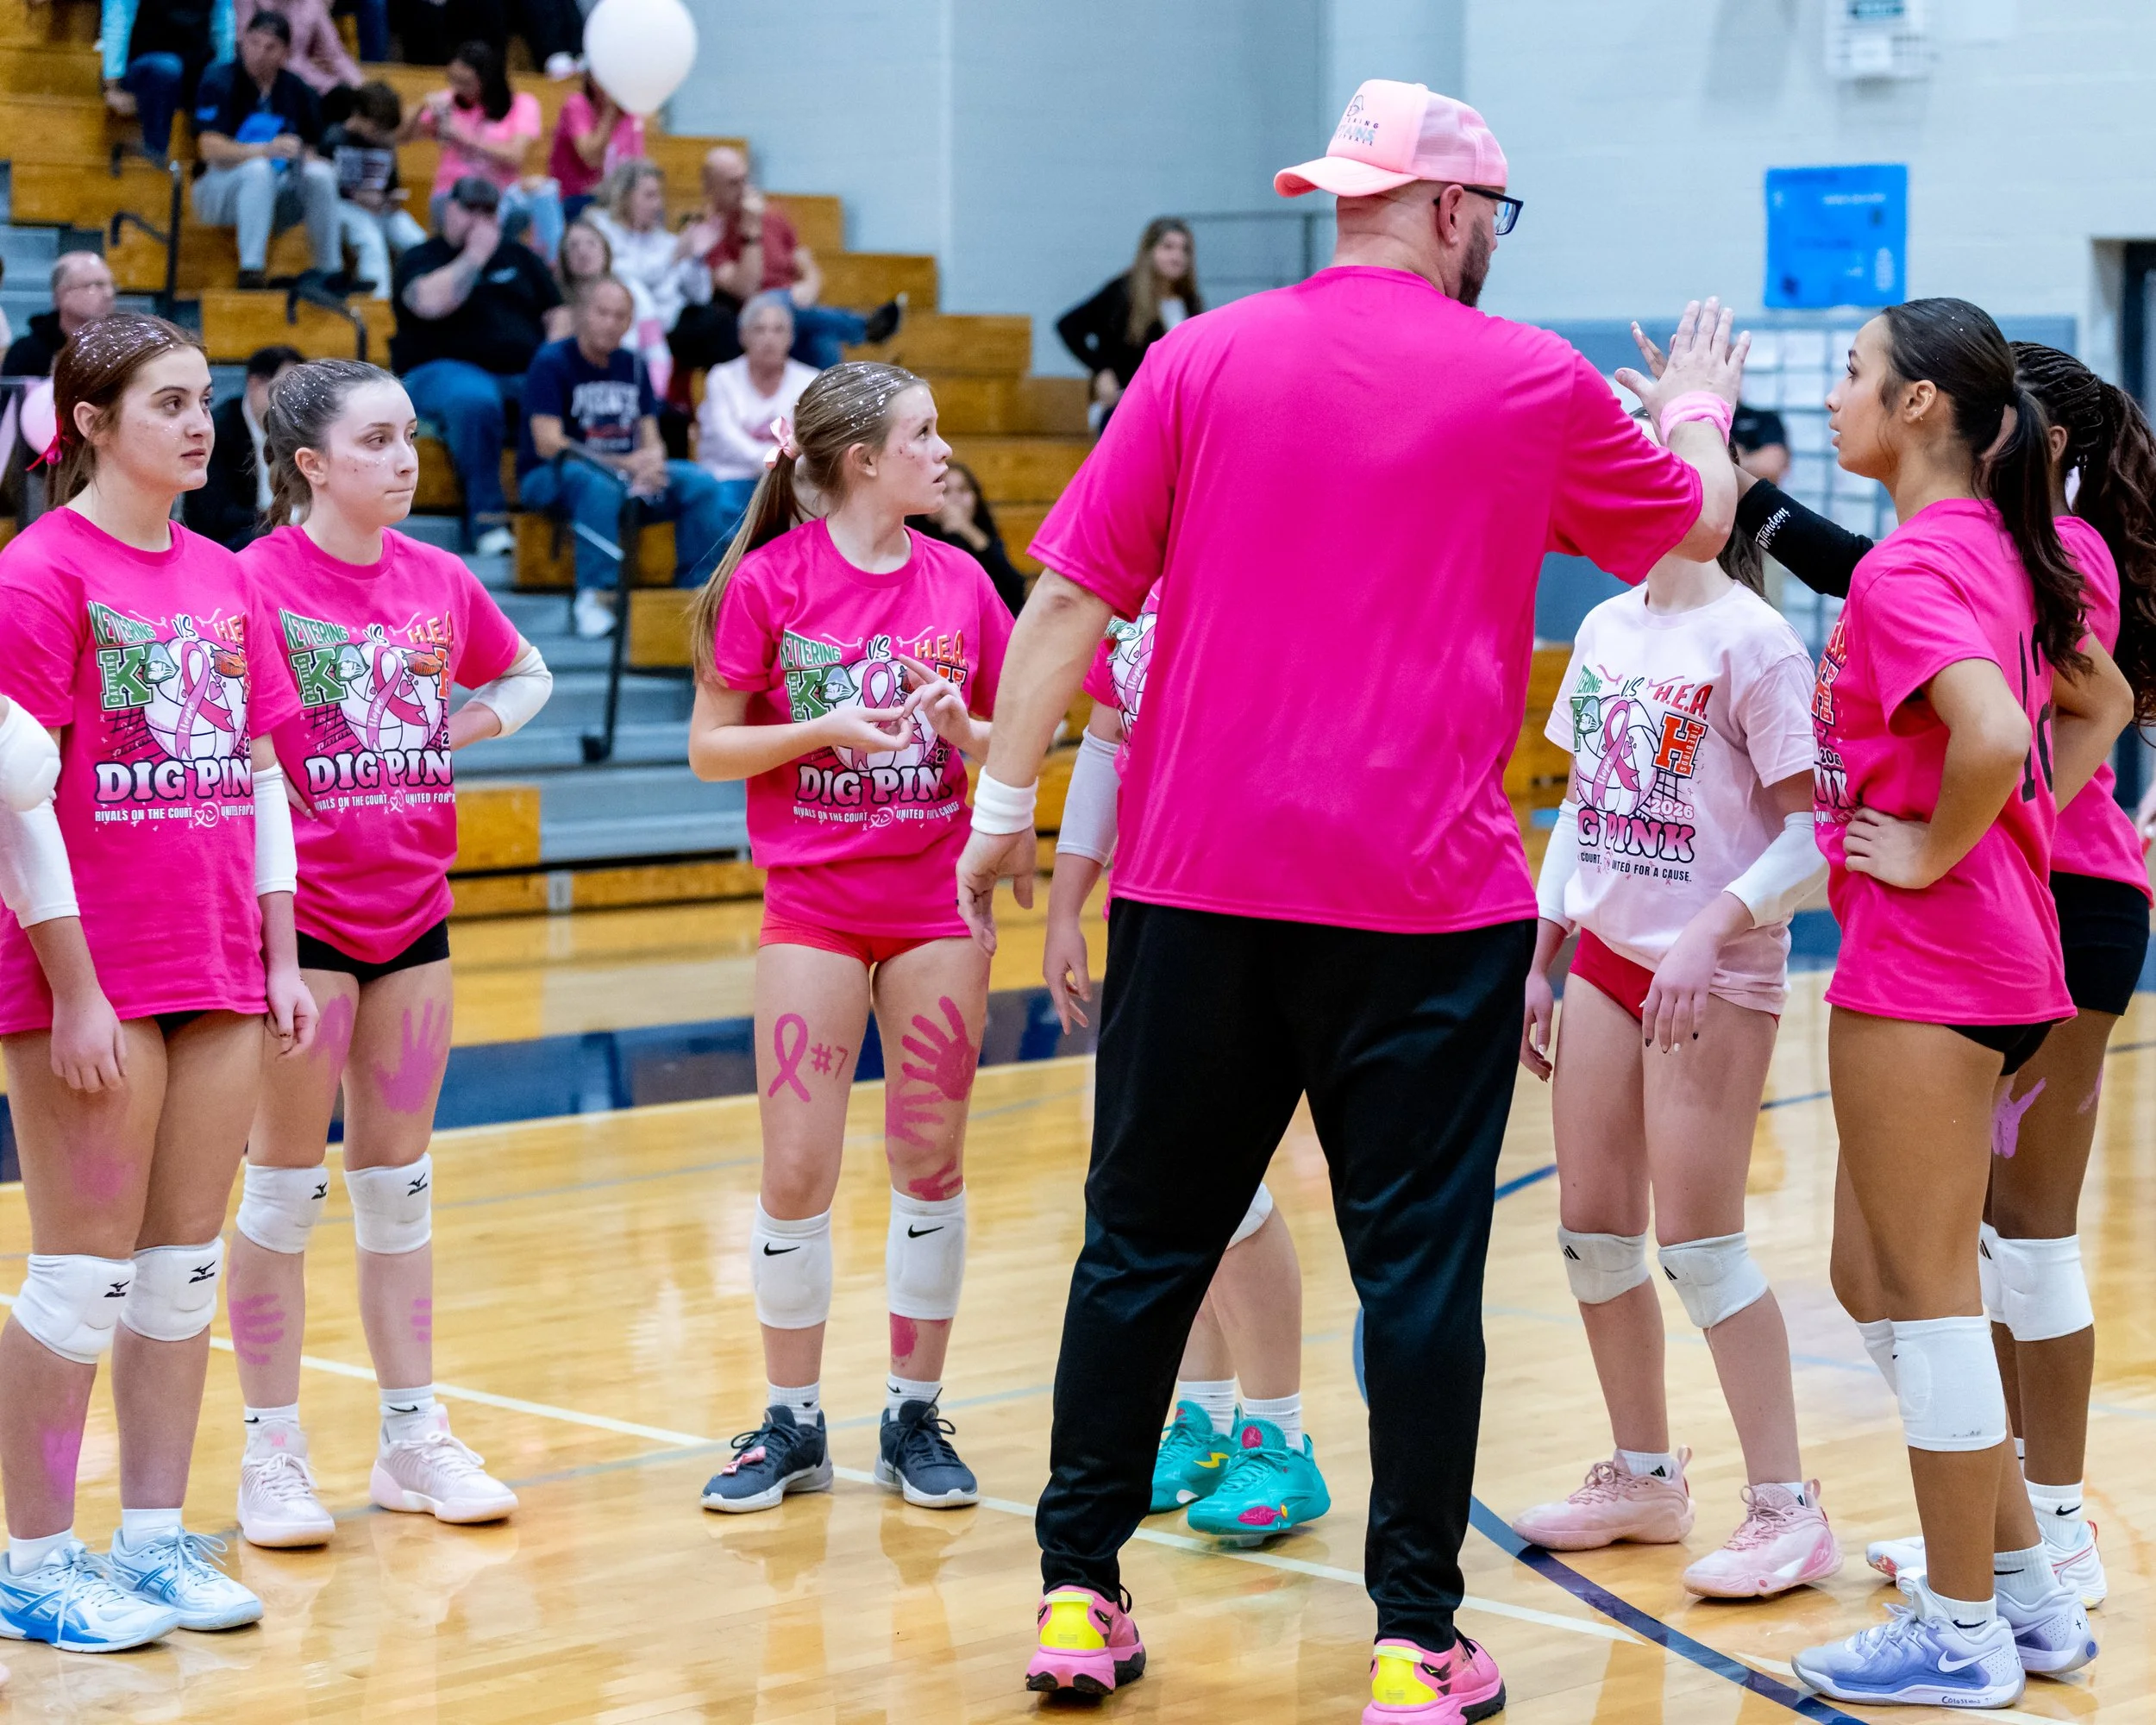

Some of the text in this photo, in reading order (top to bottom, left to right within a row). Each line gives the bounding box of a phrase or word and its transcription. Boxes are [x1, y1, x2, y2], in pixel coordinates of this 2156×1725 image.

[1755, 507, 1791, 546] Tandem
[87, 599, 157, 646] KETTERING
[279, 607, 350, 650] KETTERING
[97, 643, 154, 710] K
[105, 655, 121, 703] CAPTAINS
[288, 645, 349, 709] K
[298, 657, 316, 701] CAPTAINS
[1125, 661, 1145, 691] Hope
[1651, 710, 1709, 780] H
[1679, 724, 1702, 772] FIREBIRDS
[94, 759, 187, 804] DIG
[304, 750, 380, 795] DIG
[795, 762, 863, 806] DIG
[95, 811, 128, 822] RIVALS
[131, 810, 145, 820] ON
[147, 808, 166, 819] THE
[338, 797, 350, 807] ON
[352, 795, 364, 806] THE
[404, 794, 430, 804] UNITED
[433, 793, 449, 803] FOR
[793, 806, 816, 819] RIVALS
[818, 811, 828, 820] ON
[829, 812, 843, 822] THE
[896, 808, 924, 820] UNITED
[1650, 799, 1695, 819] 2026
[1605, 812, 1696, 864] PINK
[1633, 864, 1651, 876] FOR
[1653, 867, 1658, 878] A
[811, 1043, 849, 1081] #7
